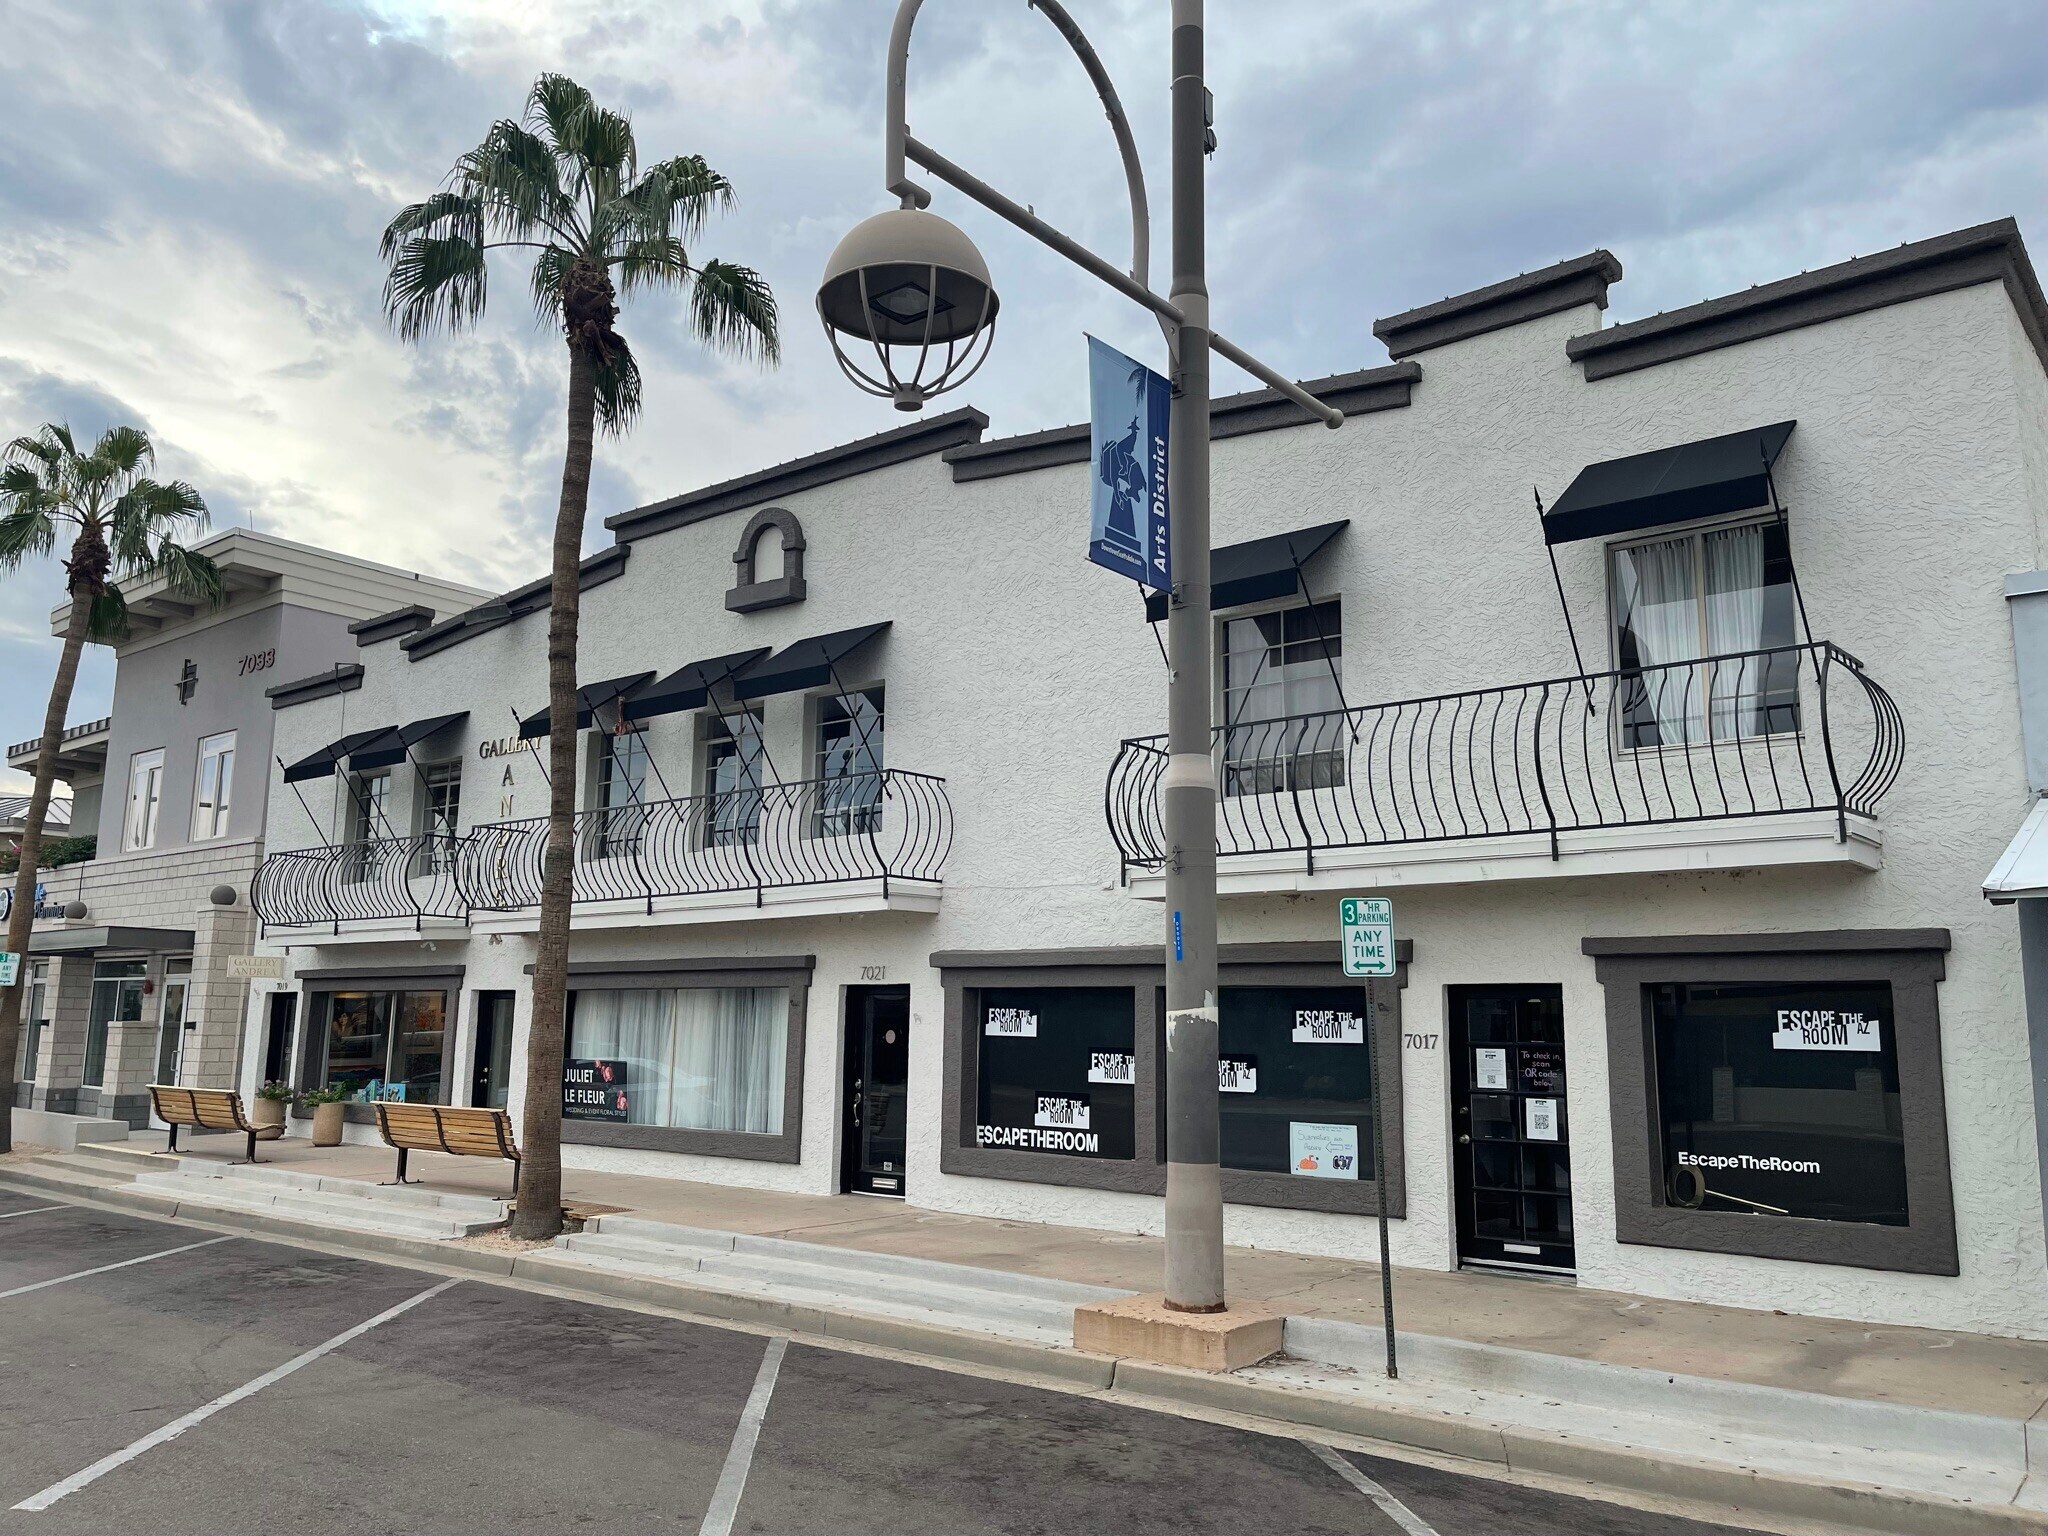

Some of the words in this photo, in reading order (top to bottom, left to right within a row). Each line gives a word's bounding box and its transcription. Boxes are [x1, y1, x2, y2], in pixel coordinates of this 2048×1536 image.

[1152, 435, 1166, 518] District
[1153, 524, 1166, 574] Arts
[238, 648, 276, 676] 7033
[1344, 904, 1355, 923] 3
[1367, 903, 1380, 913] HR
[1358, 913, 1389, 923] PARKING
[1353, 930, 1382, 942] ANY
[1352, 945, 1385, 958] TIME
[234, 958, 278, 967] GALLERY
[233, 967, 277, 976] ANDREA
[860, 965, 886, 980] 7021
[989, 1008, 1017, 1023] ESCAPE
[1018, 1009, 1030, 1018] THE
[1295, 1010, 1335, 1028] ESCAPE
[1336, 1012, 1353, 1021] THE
[1777, 1010, 1835, 1031] ESCAPE
[1839, 1012, 1864, 1025] THE
[1000, 1019, 1022, 1033] ROOM
[1312, 1022, 1342, 1039] ROOM
[1348, 1019, 1357, 1030] AZ
[1802, 1024, 1849, 1046] ROOM
[1857, 1022, 1871, 1035] AZ
[1404, 1034, 1439, 1050] 7017
[1092, 1052, 1123, 1068] ESCAPE
[1124, 1055, 1135, 1065] TH
[1520, 1050, 1531, 1059] To
[1532, 1051, 1551, 1060] check
[1104, 1064, 1129, 1080] ROOM
[1232, 1062, 1248, 1071] THE
[1524, 1067, 1538, 1078] QR
[1538, 1069, 1558, 1078] code
[564, 1068, 594, 1083] JULIET
[1243, 1069, 1251, 1080] AZ
[564, 1088, 575, 1103] LE
[577, 1089, 605, 1105] FLEUR
[1038, 1097, 1068, 1112] ESCAPE
[1069, 1099, 1082, 1109] THE
[1050, 1109, 1074, 1124] ROOM
[976, 1124, 1099, 1153] ESCAPETHEROOM
[1678, 1151, 1821, 1174] EscapeTheRoom
